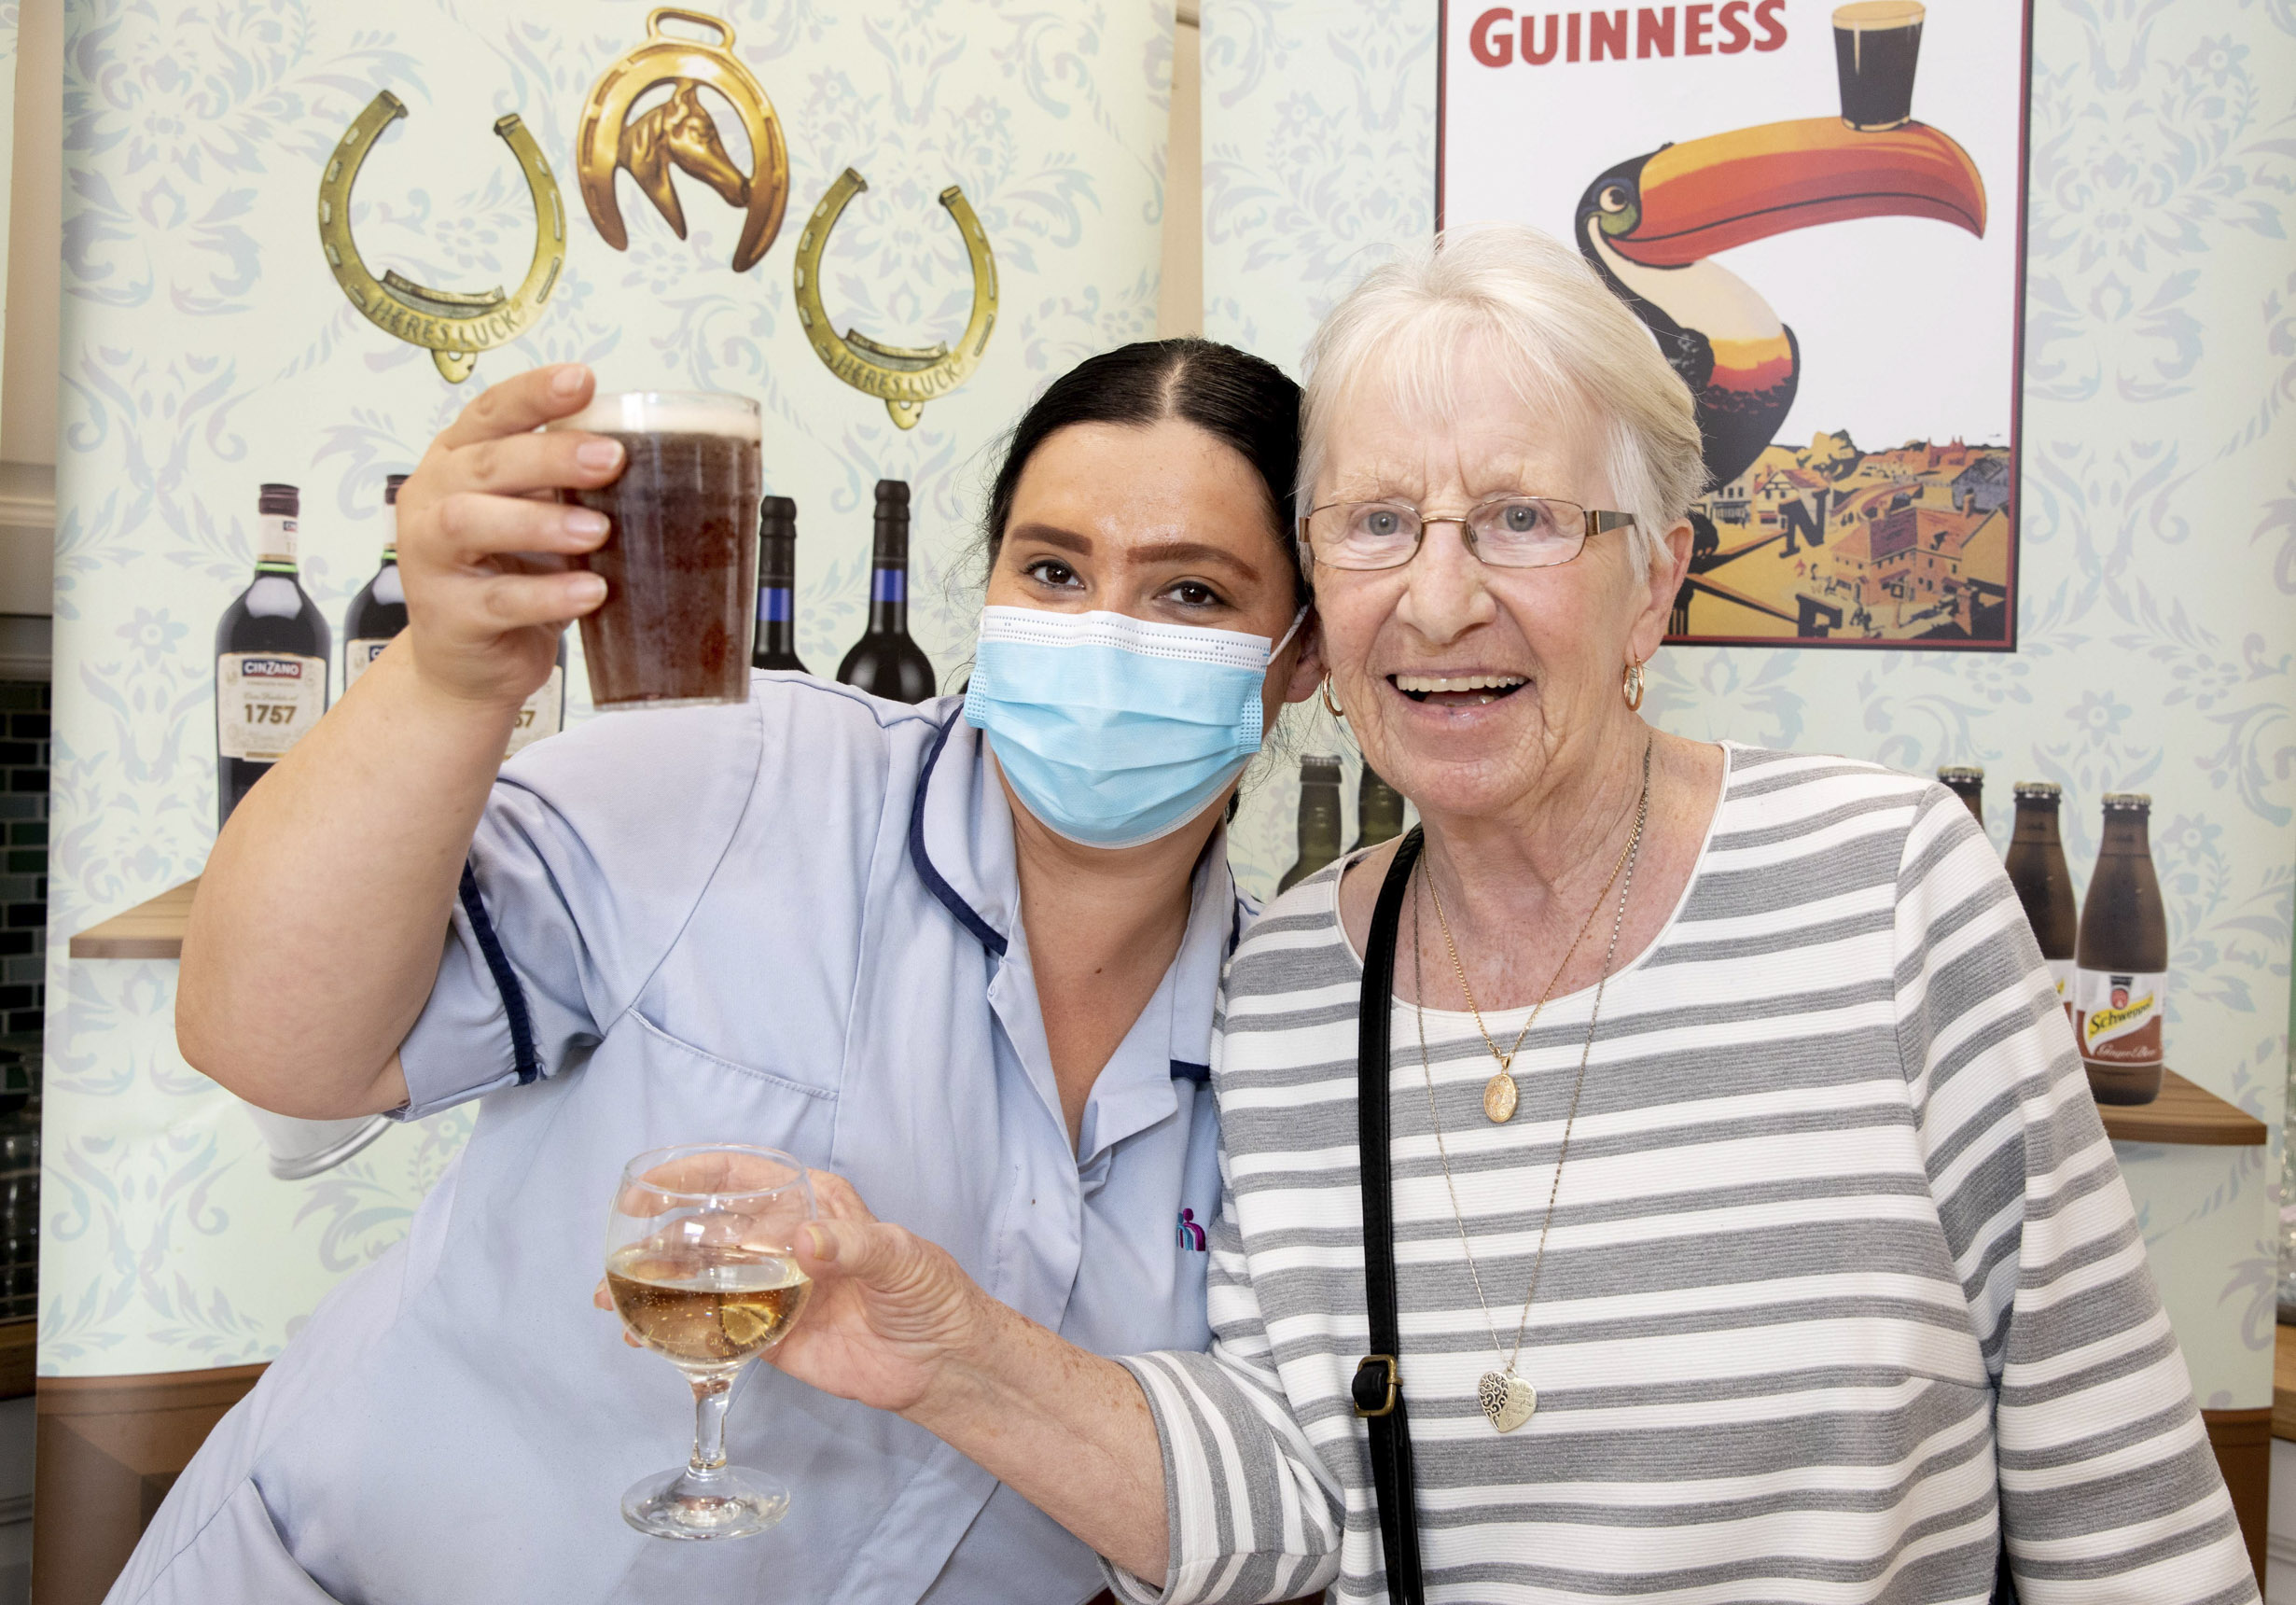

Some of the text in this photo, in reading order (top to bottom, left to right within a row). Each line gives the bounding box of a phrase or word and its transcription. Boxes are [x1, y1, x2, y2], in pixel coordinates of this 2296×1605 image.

[1469, 0, 1788, 68] GUINNESS
[458, 310, 521, 348] LUCK
[908, 362, 959, 397] LUCK
[244, 661, 299, 677] CINZANO
[244, 704, 297, 725] 1757
